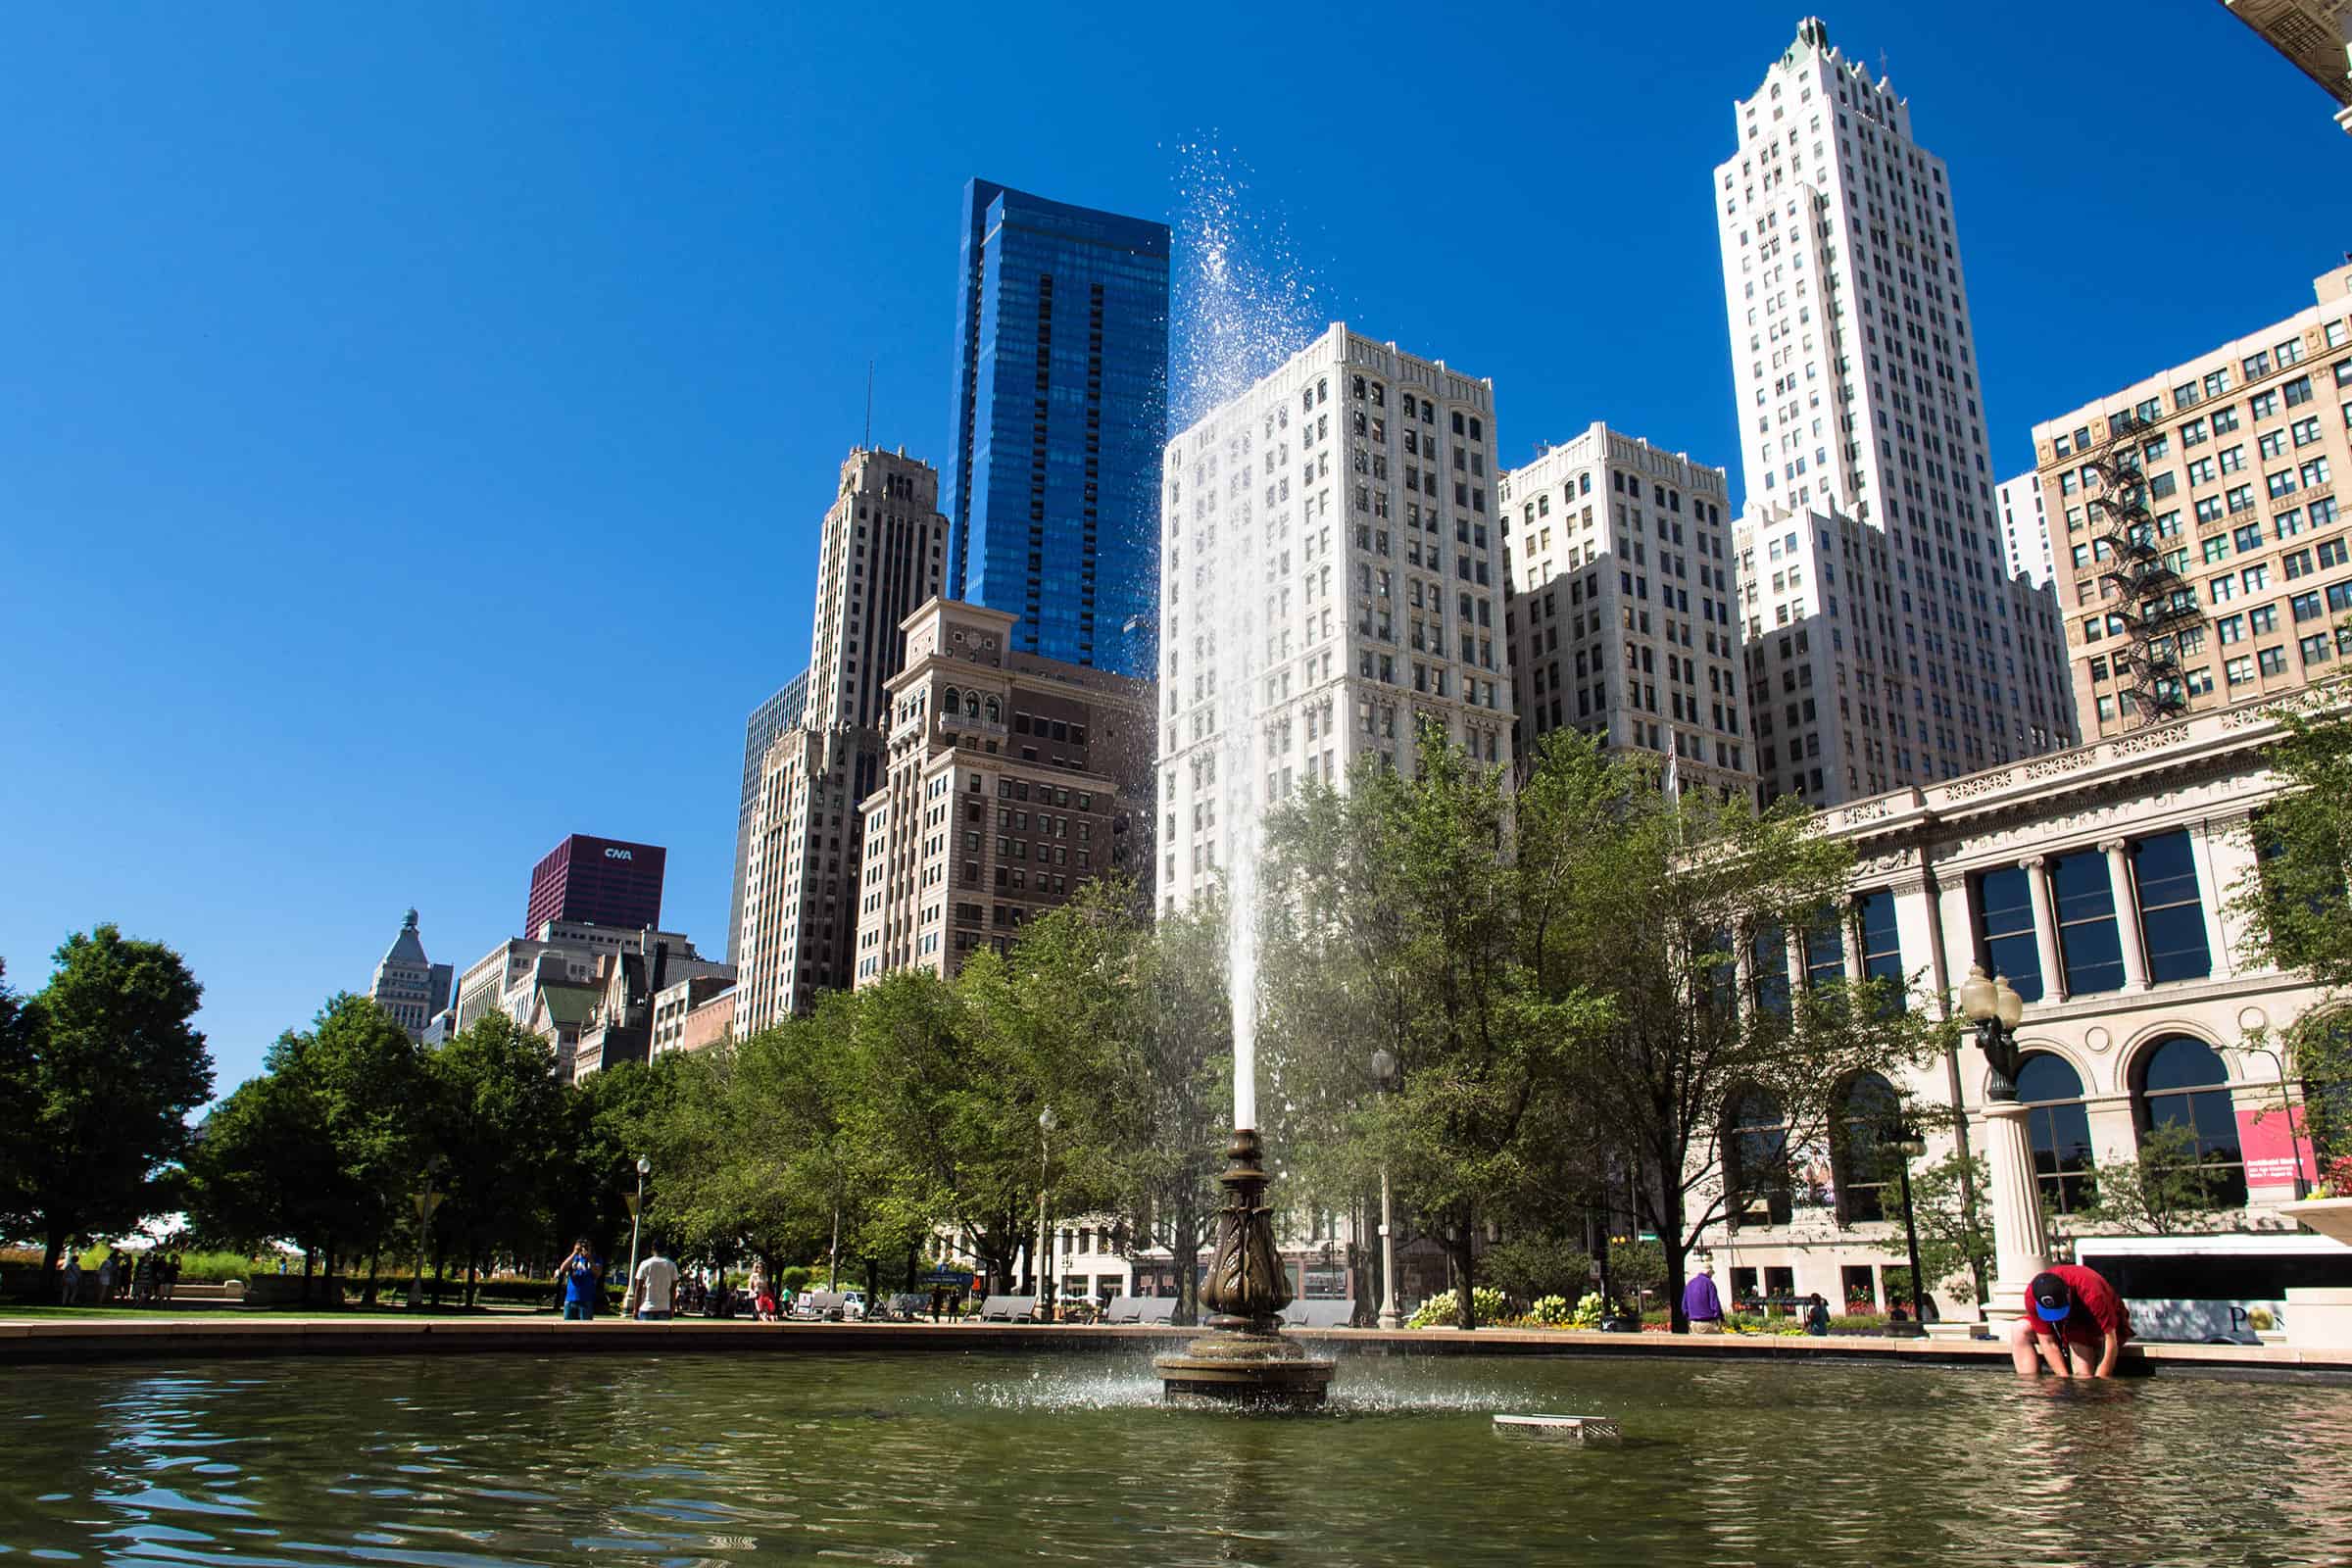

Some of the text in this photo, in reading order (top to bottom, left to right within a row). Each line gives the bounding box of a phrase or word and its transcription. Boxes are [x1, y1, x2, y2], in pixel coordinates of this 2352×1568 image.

[2041, 802, 2132, 835] LIBRARY
[2155, 792, 2179, 808] OF
[2205, 776, 2250, 798] THE
[605, 848, 632, 861] CNA
